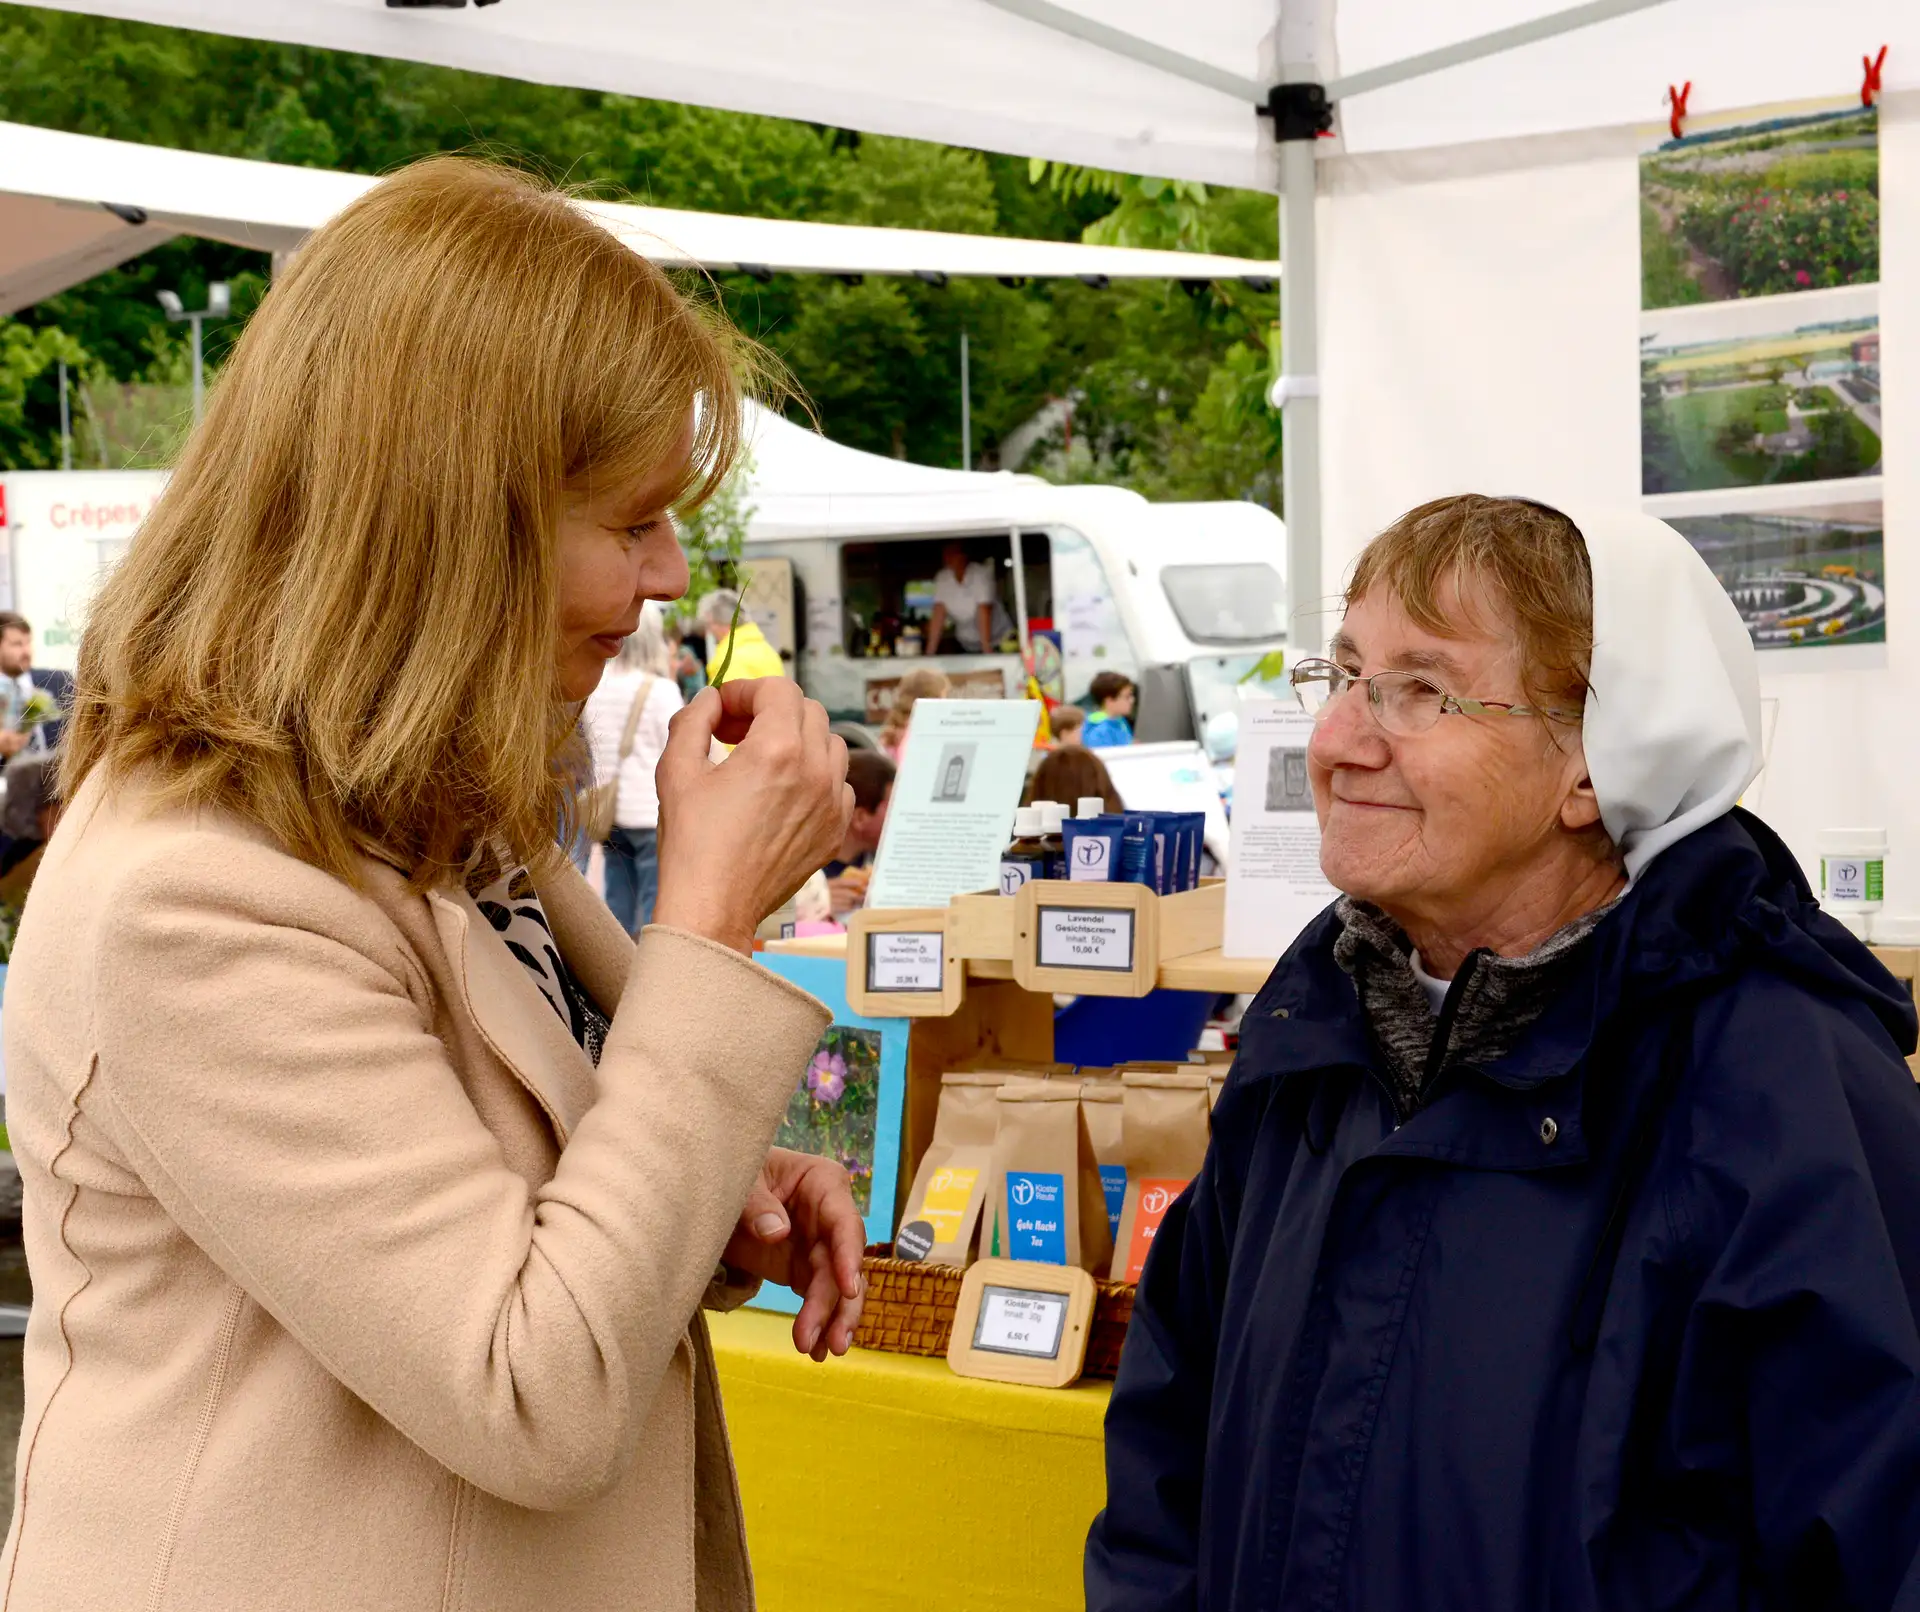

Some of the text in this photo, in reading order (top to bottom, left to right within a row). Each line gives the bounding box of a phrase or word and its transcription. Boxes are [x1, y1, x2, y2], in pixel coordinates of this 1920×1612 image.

[50, 502, 140, 529] Crêpes
[1067, 914, 1105, 923] Lavendel
[1055, 924, 1116, 934] Gesichtscreme
[1091, 935, 1106, 945] 50g
[1072, 945, 1093, 954] 10,00
[1035, 1184, 1058, 1193] Kloster
[1016, 1218, 1057, 1232] Gute Nacht
[1031, 1235, 1043, 1247] Tee
[1004, 1300, 1046, 1311] Kloster Tee
